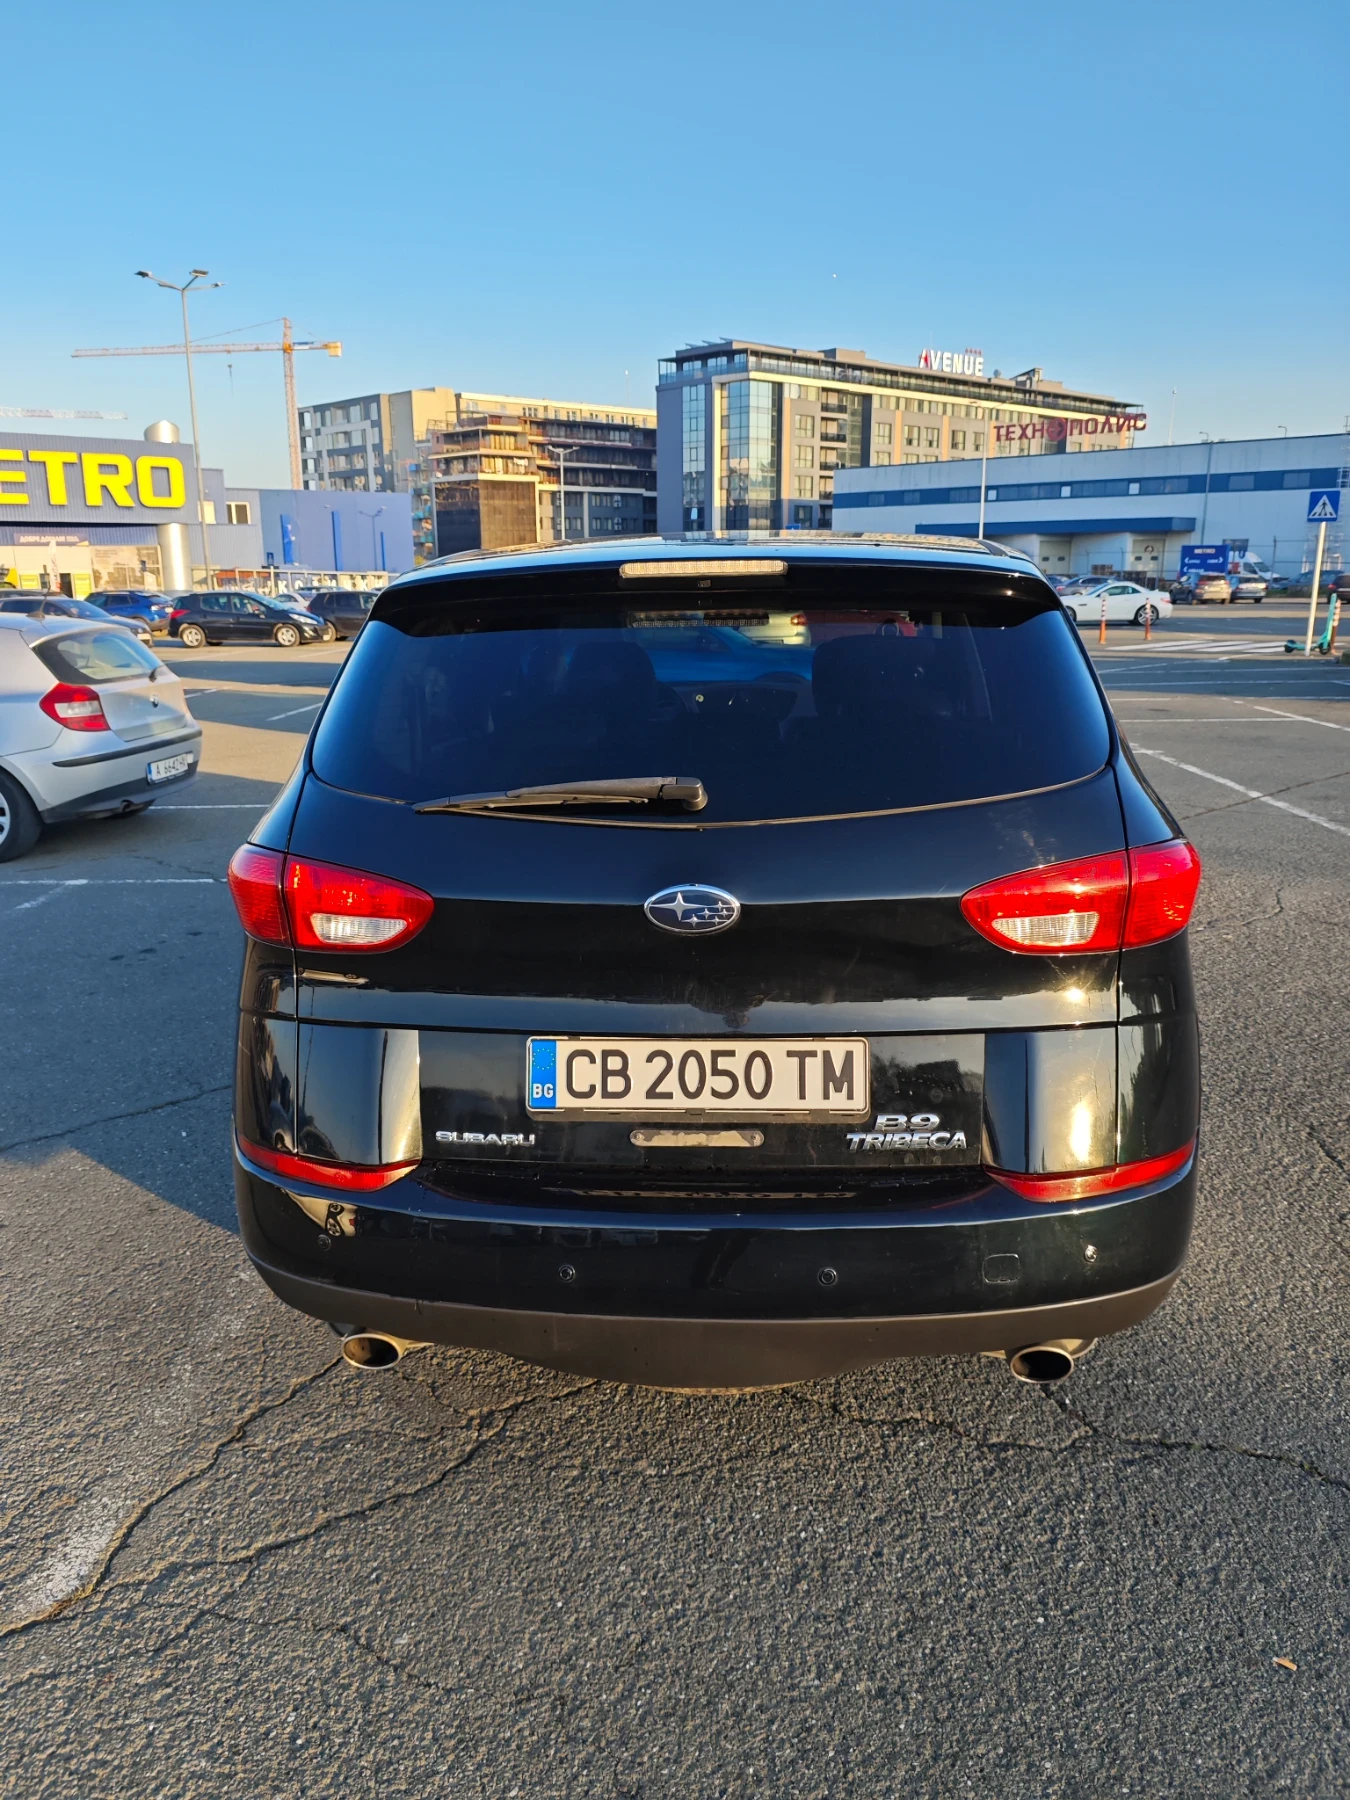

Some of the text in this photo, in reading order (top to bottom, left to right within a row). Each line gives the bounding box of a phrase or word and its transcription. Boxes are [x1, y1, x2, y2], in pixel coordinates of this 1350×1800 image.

[919, 348, 984, 377] AVENUE
[566, 1049, 855, 1101] CB 2050 TM
[532, 1083, 554, 1099] BG
[875, 1113, 940, 1131] B9
[435, 1130, 536, 1147] SUBARU
[845, 1131, 968, 1151] TRIBECA
